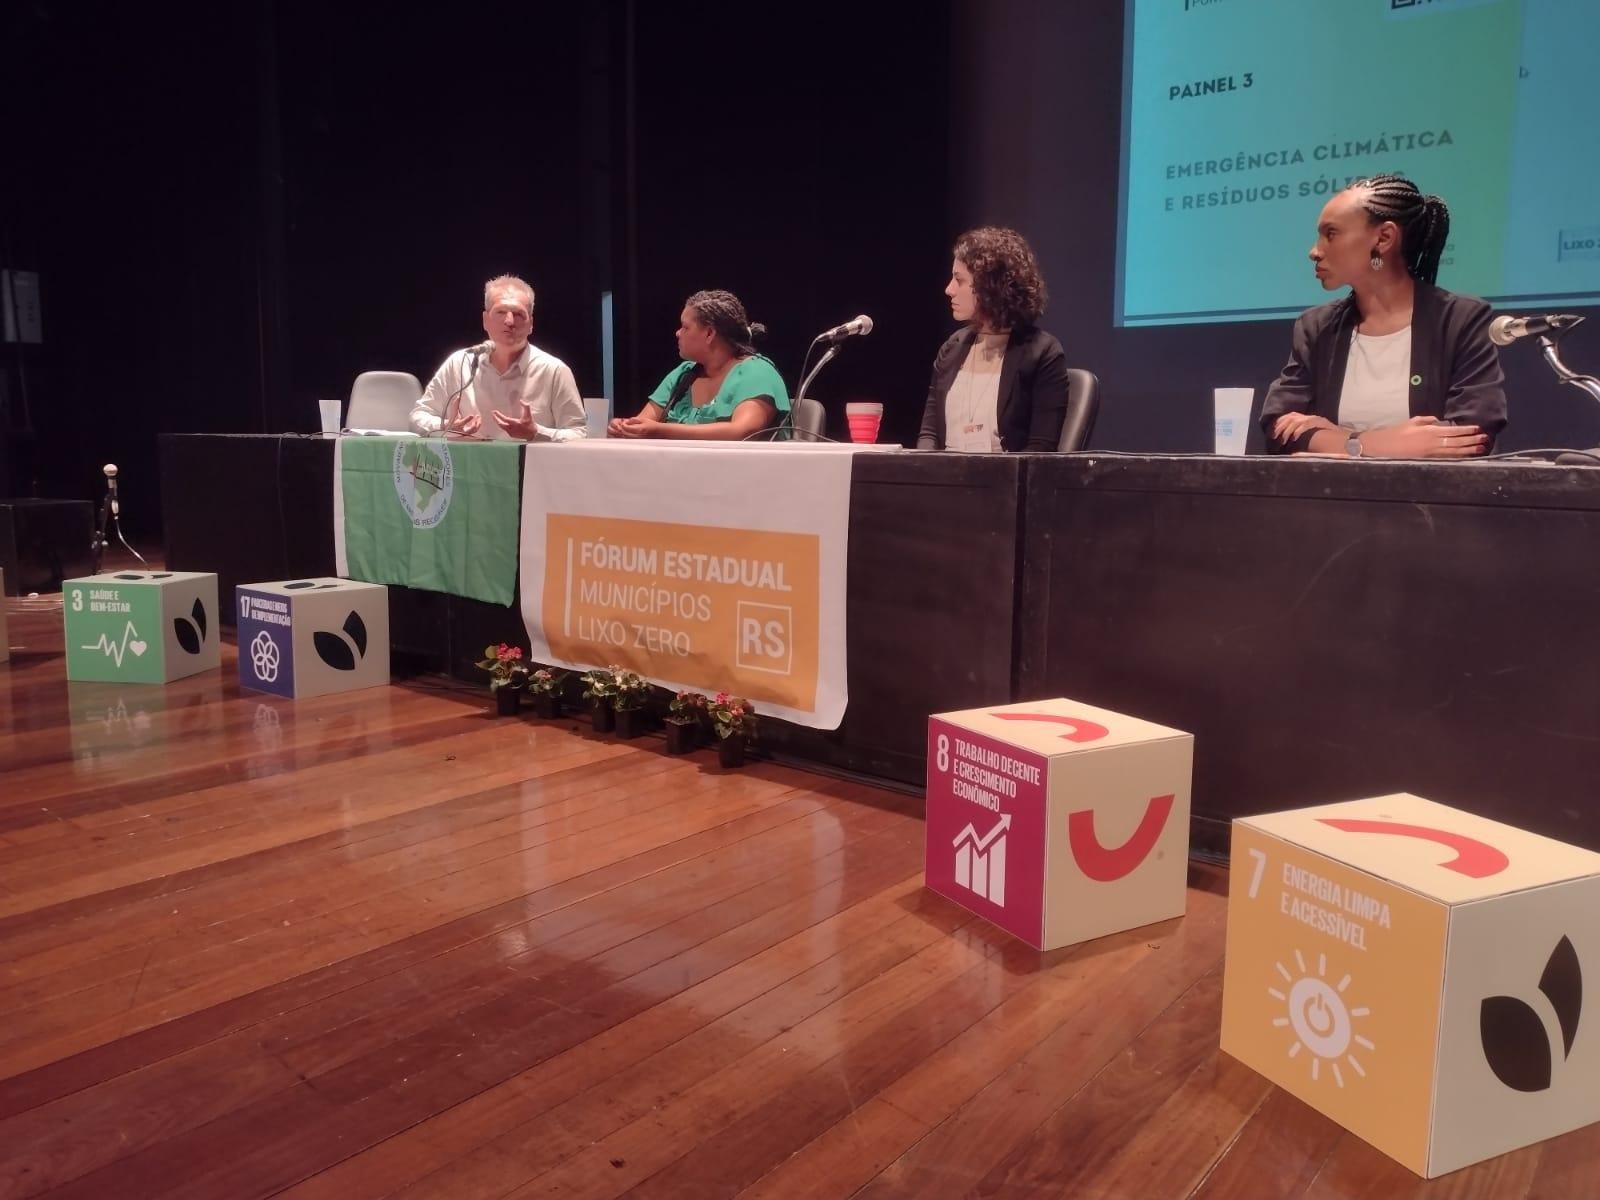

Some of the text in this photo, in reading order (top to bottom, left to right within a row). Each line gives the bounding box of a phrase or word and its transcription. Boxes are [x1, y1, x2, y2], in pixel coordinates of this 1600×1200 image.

[1169, 72, 1253, 101] PAINEL 3
[1166, 130, 1453, 180] EMERGÊNCIA CLIMÁTICA
[1165, 197, 1174, 211] E
[1182, 185, 1290, 210] RESÍDUOS
[580, 537, 792, 592] FÓRUM ESTADUAL
[72, 589, 83, 611] 3
[241, 595, 250, 618] 17
[580, 579, 711, 622] MUNICÍPIOS
[579, 616, 690, 657] LIXO ZERO
[742, 617, 785, 658] RS
[937, 734, 949, 772] 8
[955, 738, 1040, 786] TRABALHO DECENTE
[953, 758, 1016, 798] E CRESCIMENTO
[953, 778, 1000, 813] ECONÔMICO
[1249, 848, 1266, 899] 7
[1283, 862, 1391, 929] ENERGIA LIMPA
[1281, 892, 1367, 952] E ACESSÍVEL
